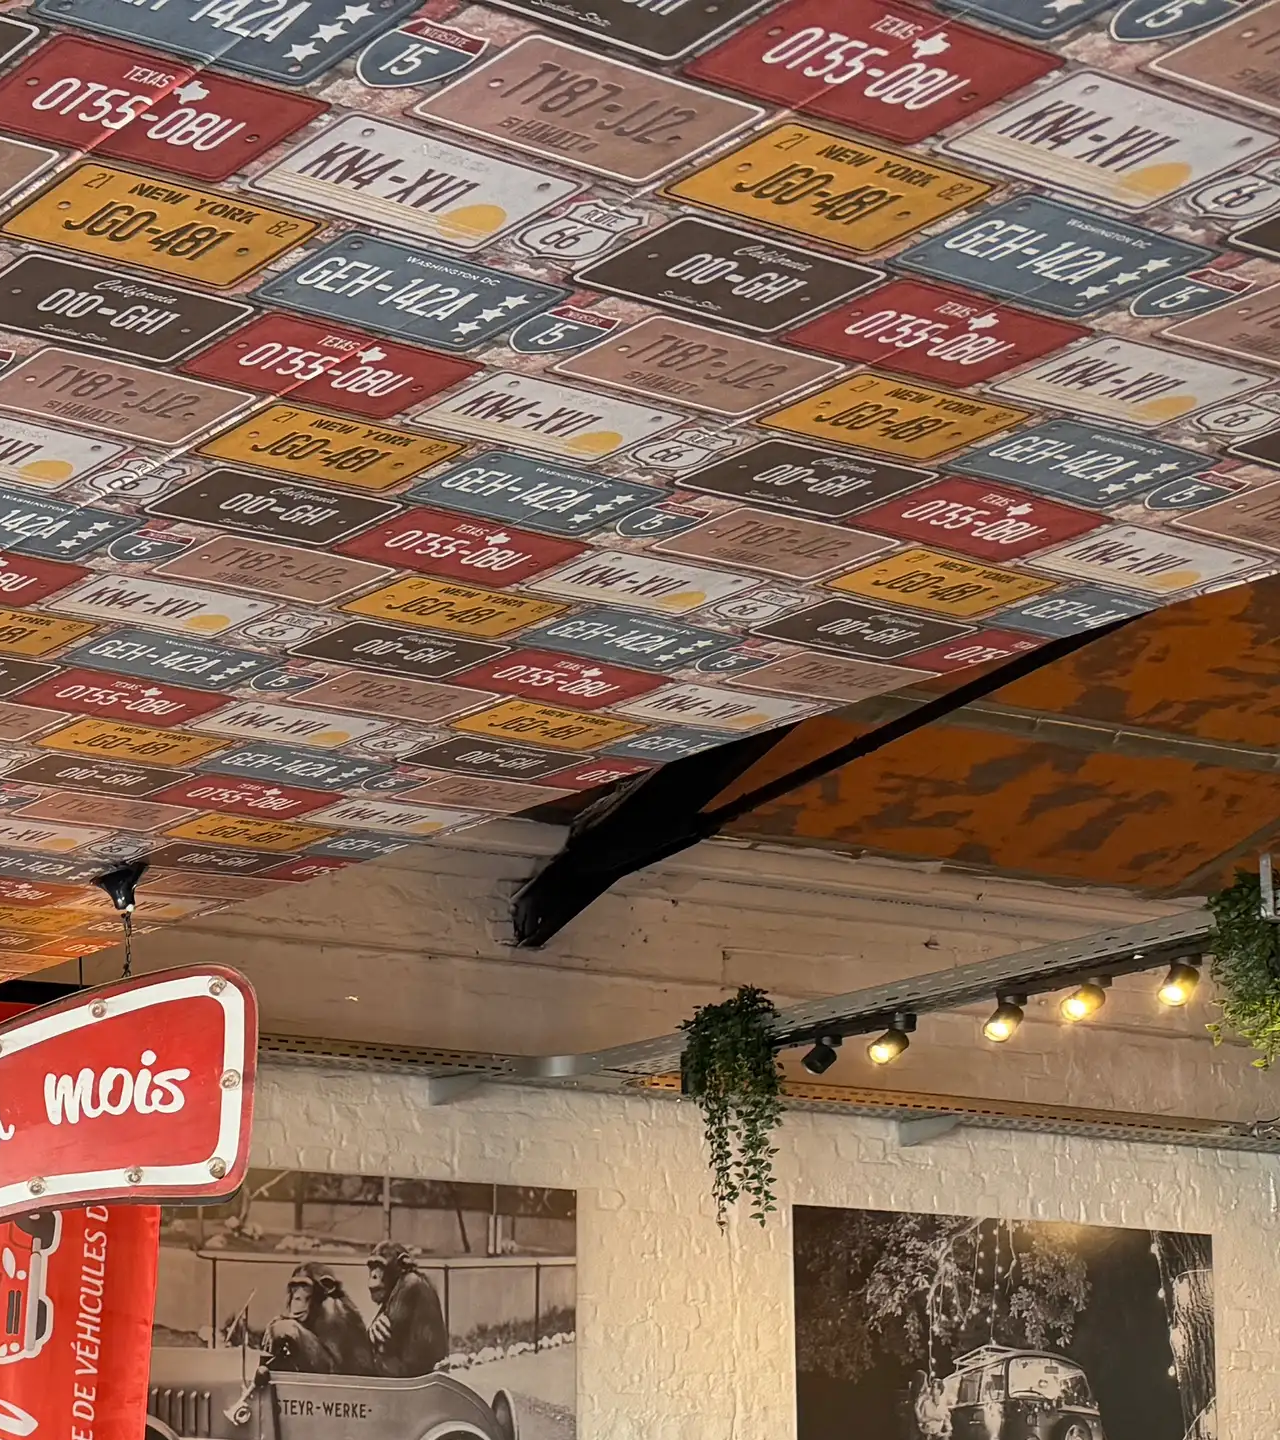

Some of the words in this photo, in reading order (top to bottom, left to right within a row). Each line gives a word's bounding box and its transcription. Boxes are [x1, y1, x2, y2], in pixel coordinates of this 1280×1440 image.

[869, 13, 920, 40] TEXAS
[121, 65, 173, 89] TEXAS
[380, 44, 426, 75] 15
[500, 62, 697, 143] TY87-JJ2
[997, 100, 1182, 173] KN4-XV1
[300, 142, 480, 213] KN4-XV1
[816, 143, 873, 169] NEW
[873, 160, 941, 188] YORK
[128, 182, 185, 207] NEW
[195, 197, 259, 226] YORK
[943, 219, 1123, 286] GEH-142A
[295, 256, 479, 322] GEH-142A
[83, 587, 203, 625] KN4-XV1
[89, 639, 219, 675] GEH-142A
[44, 1050, 191, 1125] mois
[71, 1228, 107, 1375] VÉHICULES
[73, 1382, 96, 1421] DE
